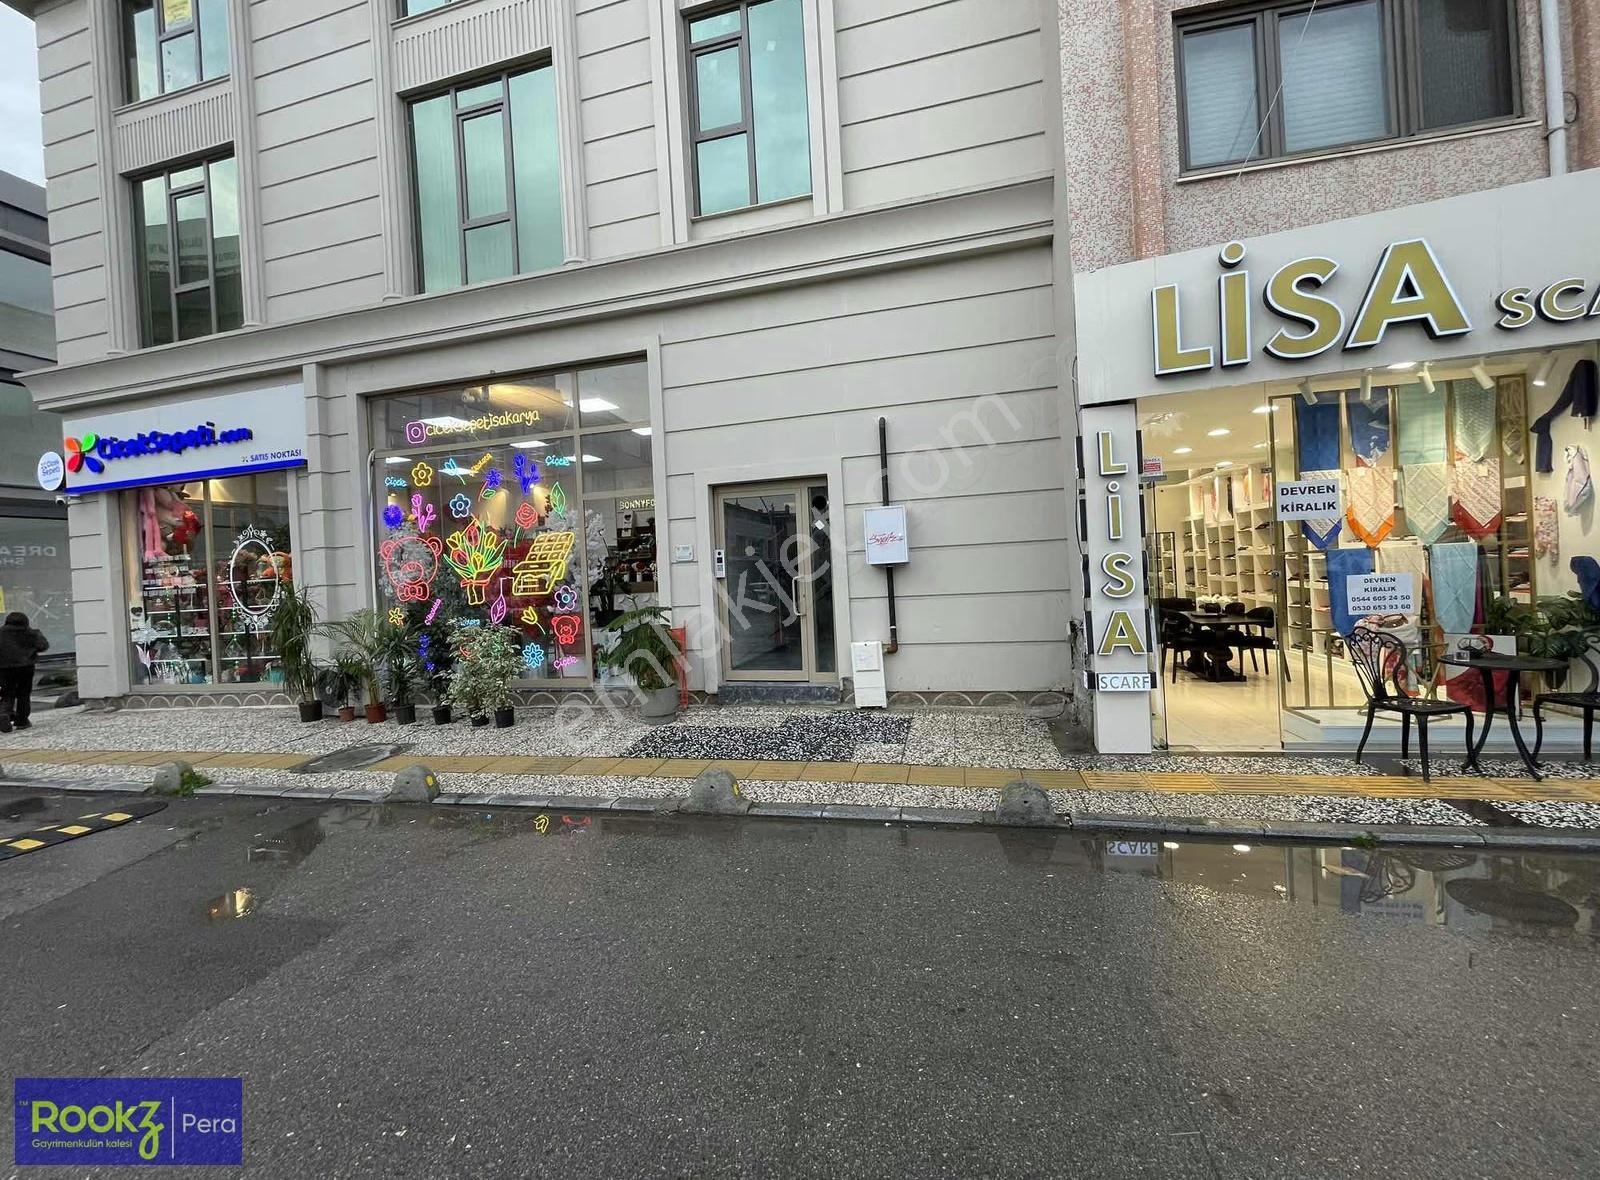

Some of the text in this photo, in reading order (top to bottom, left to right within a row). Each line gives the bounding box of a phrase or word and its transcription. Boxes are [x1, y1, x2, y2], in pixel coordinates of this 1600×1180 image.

[1281, 485, 1335, 496] DEVREN
[1281, 501, 1336, 512] KİRALIK
[1100, 676, 1149, 689] SCARF
